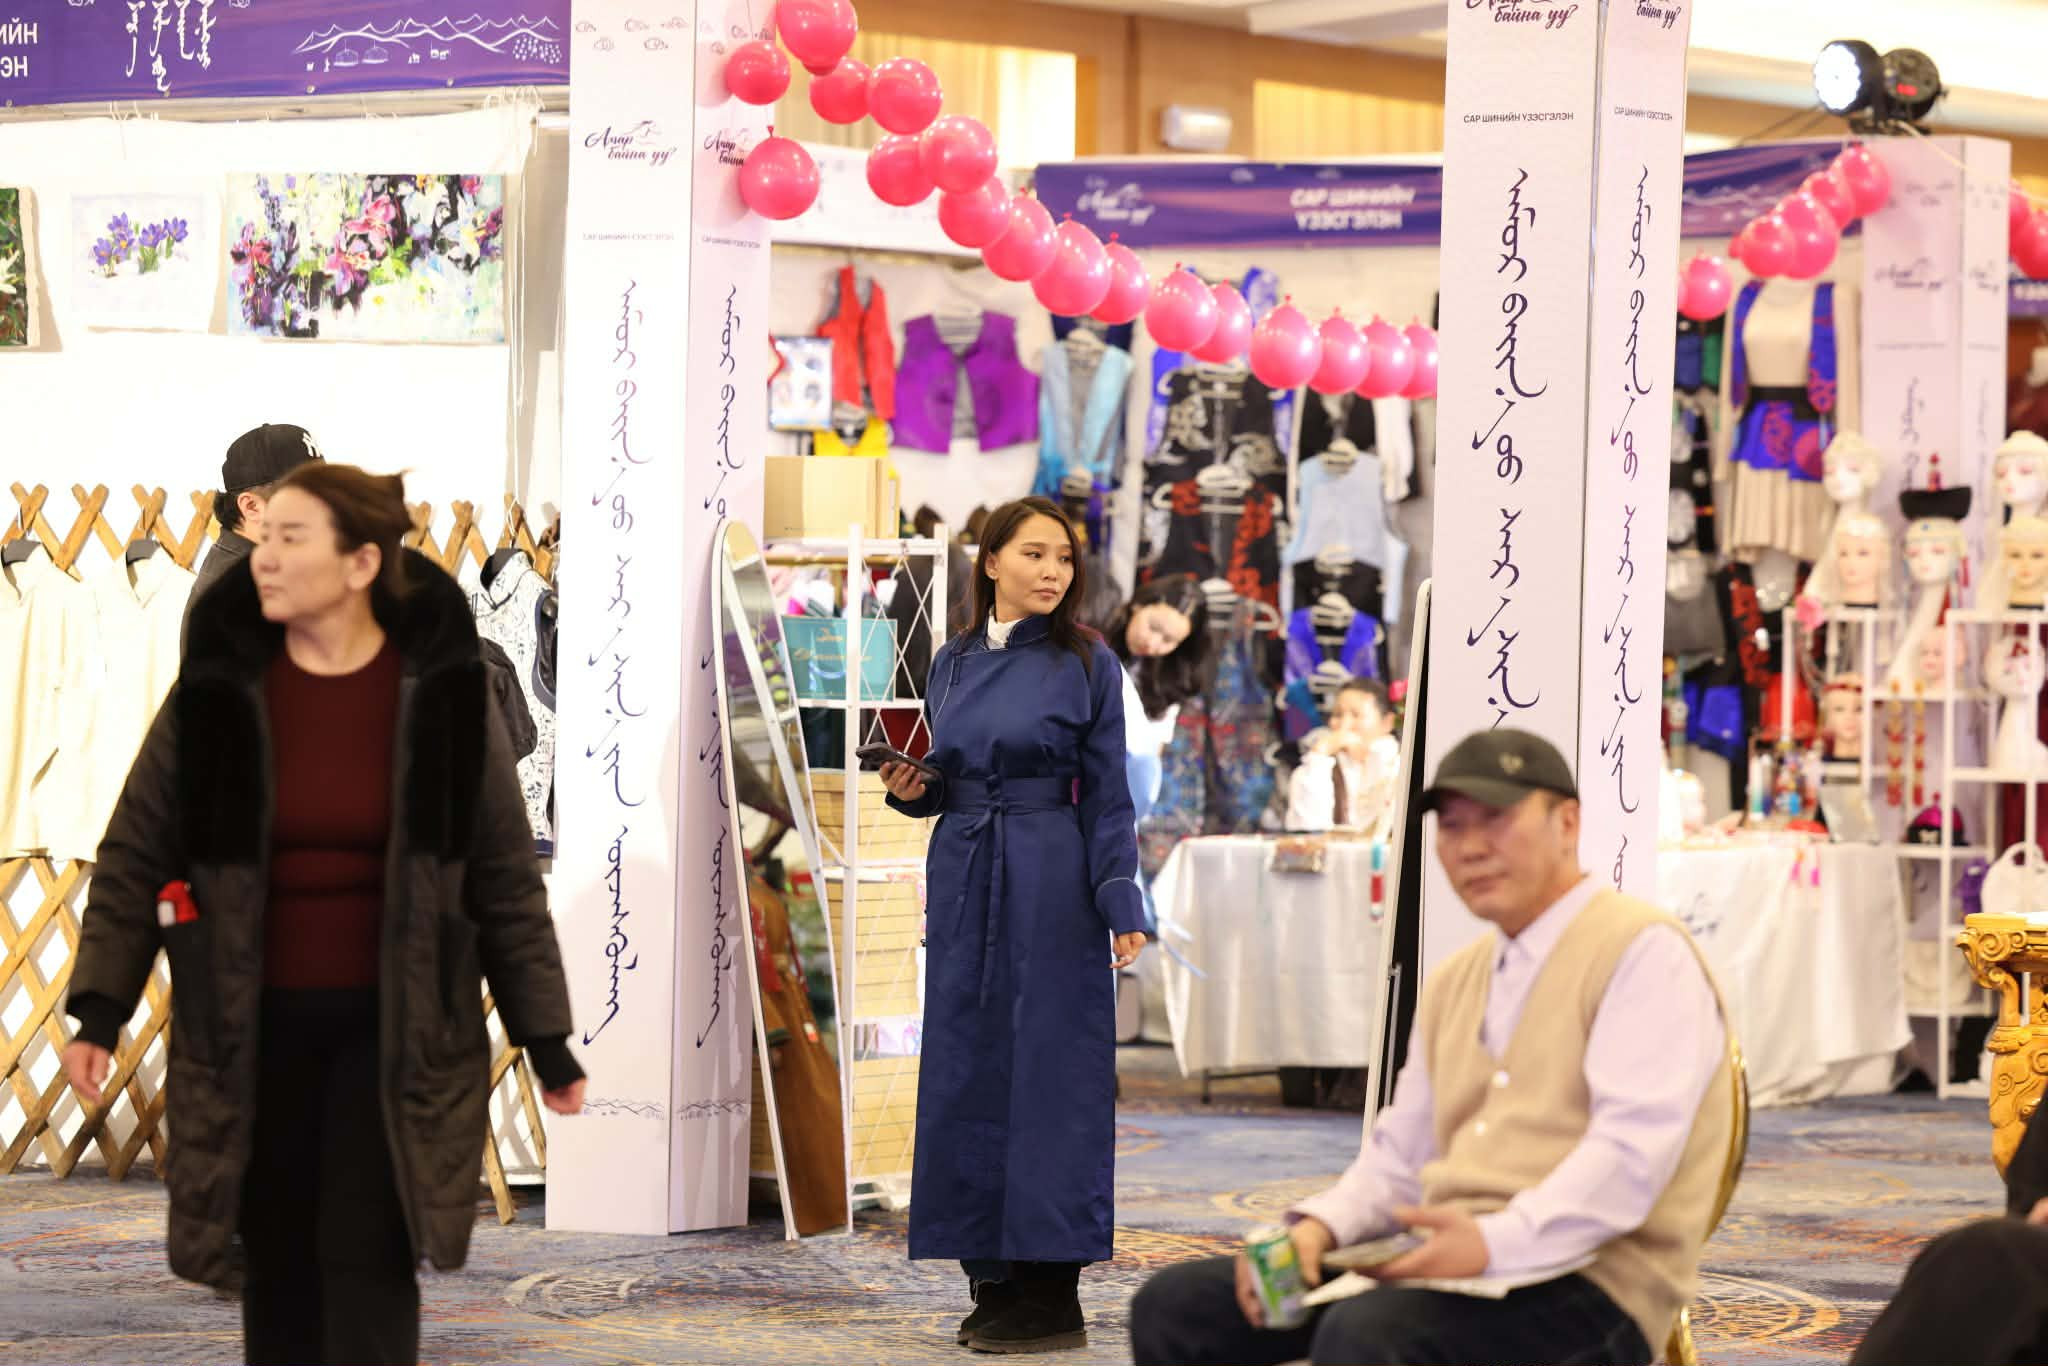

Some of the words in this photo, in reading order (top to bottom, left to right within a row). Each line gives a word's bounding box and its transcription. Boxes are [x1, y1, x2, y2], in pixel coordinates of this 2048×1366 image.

[1464, 113, 1481, 123] САР
[1482, 112, 1521, 123] ШИНИЙН
[1521, 111, 1574, 122] ҮЗЭСГЭЛЭН
